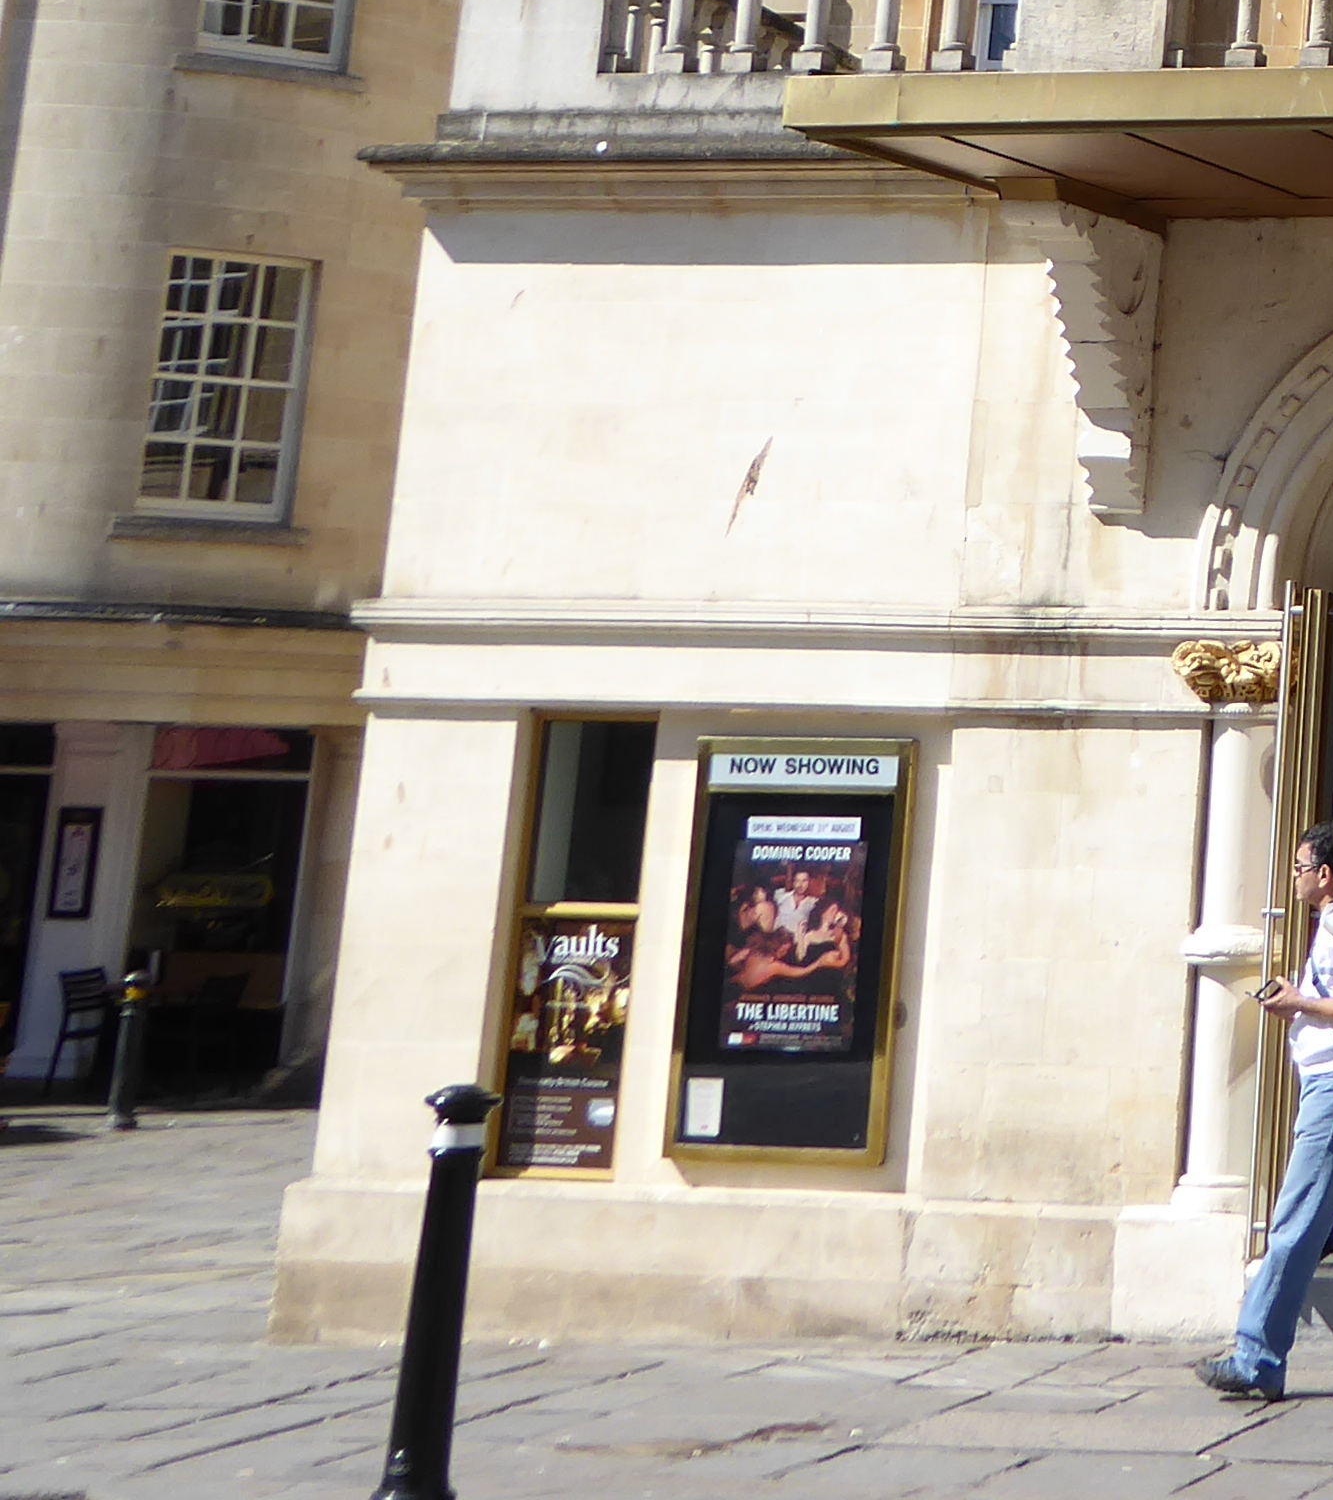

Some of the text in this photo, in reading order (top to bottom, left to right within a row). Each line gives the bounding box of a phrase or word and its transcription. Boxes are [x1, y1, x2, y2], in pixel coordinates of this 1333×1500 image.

[729, 757, 880, 775] NOW SHOWING
[751, 845, 852, 862] DOMINIC COOPER
[735, 1002, 840, 1023] THE LIBERTINE
